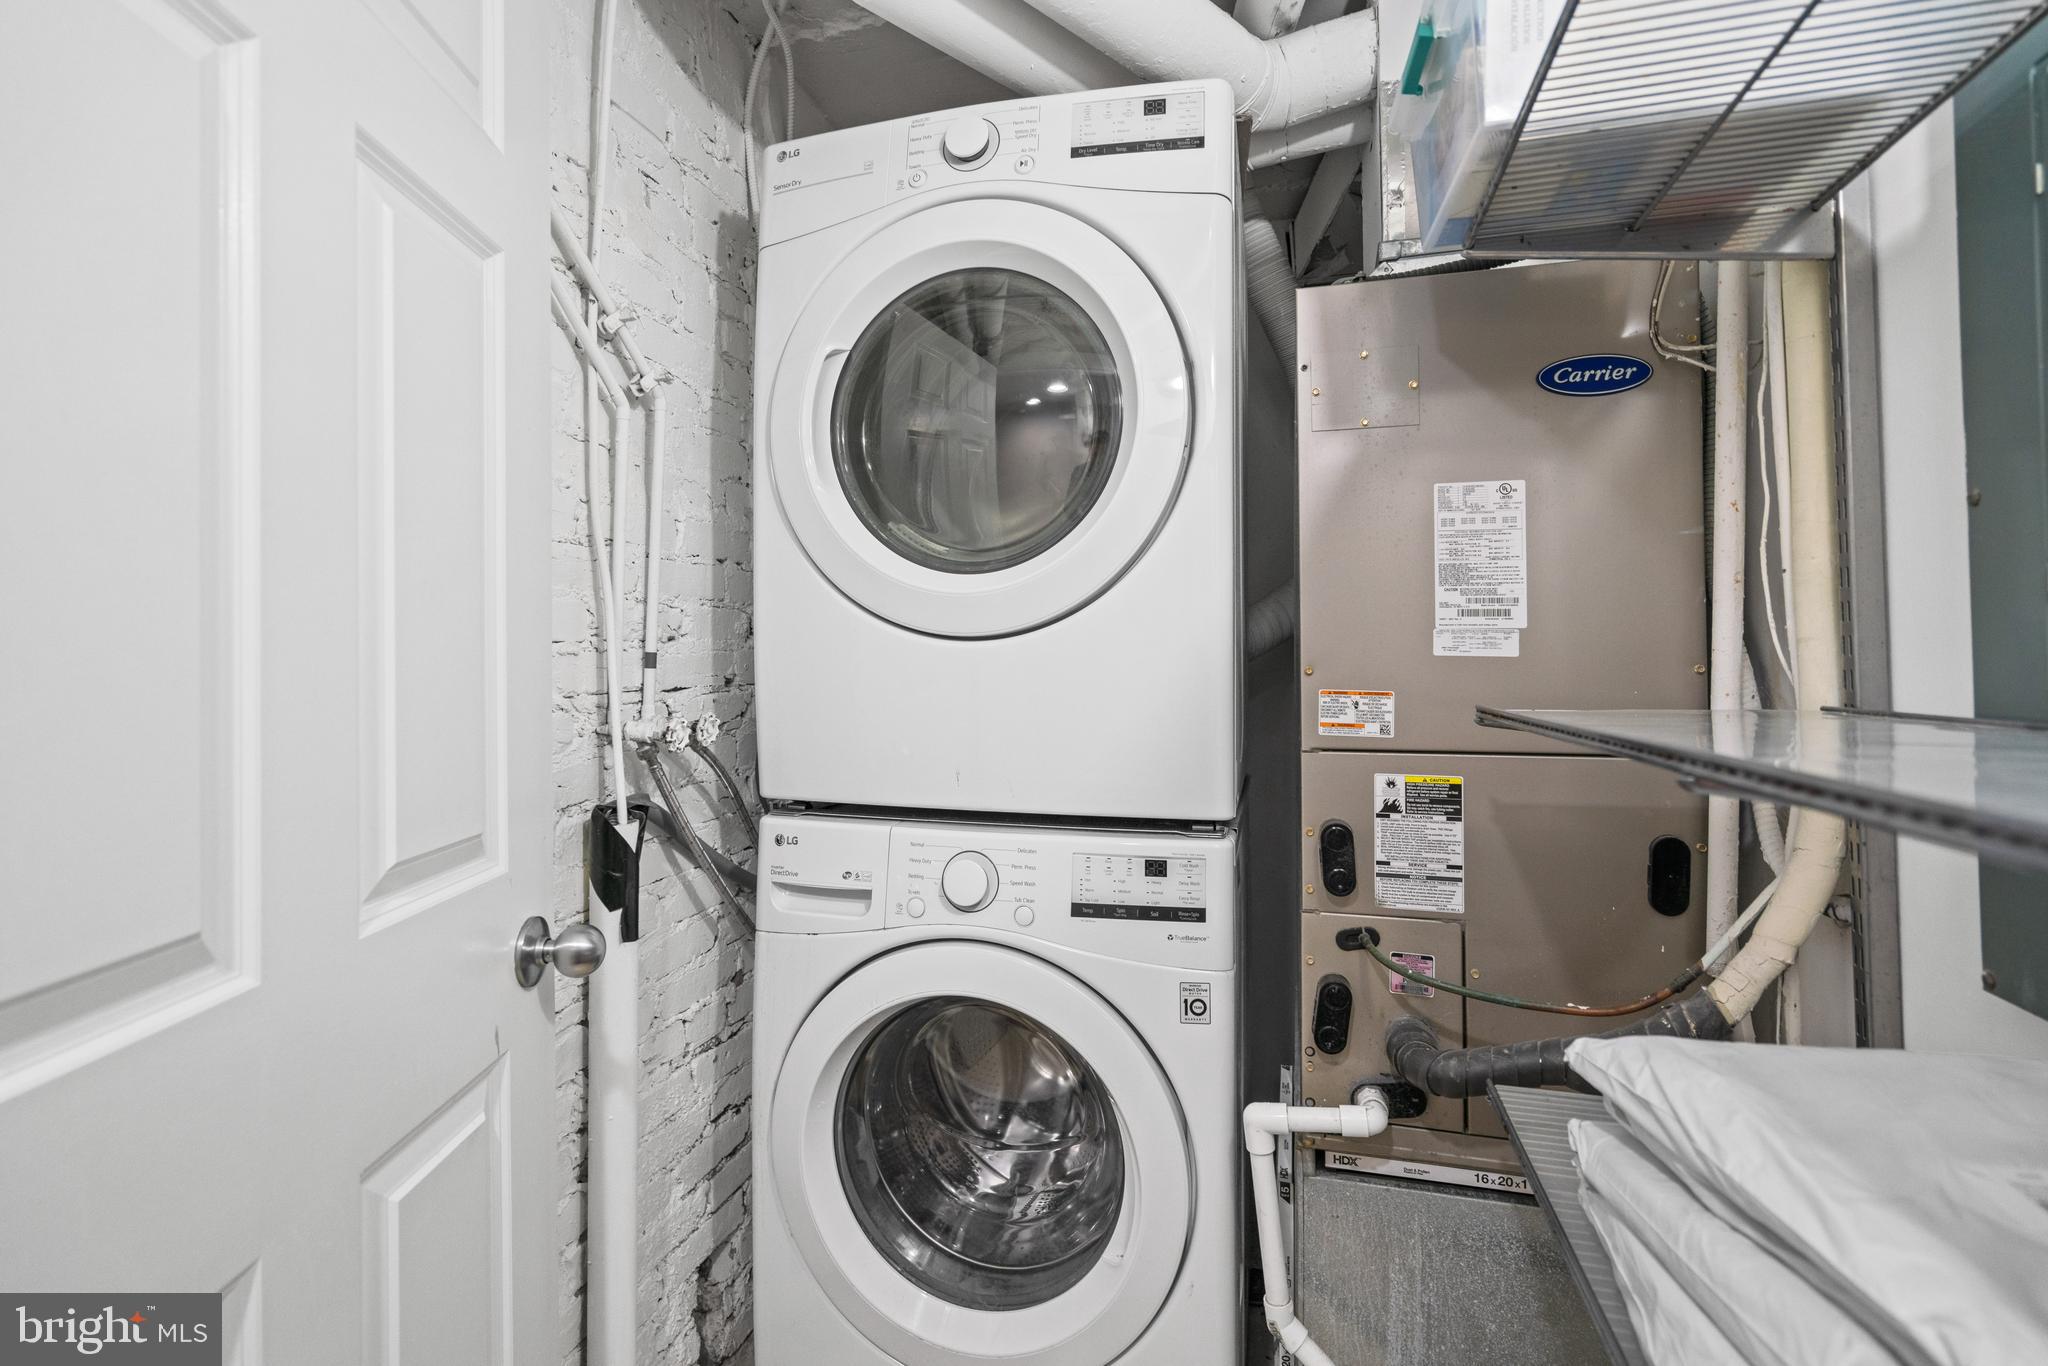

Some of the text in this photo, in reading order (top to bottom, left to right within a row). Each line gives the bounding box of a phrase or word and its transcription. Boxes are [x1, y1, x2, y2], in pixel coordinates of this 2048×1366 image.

[788, 149, 800, 159] LG
[773, 181, 790, 191] Sensor
[1554, 365, 1637, 384] Carrier
[787, 836, 798, 845] LG
[1184, 998, 1207, 1016] 10
[1334, 1154, 1359, 1167] HDX
